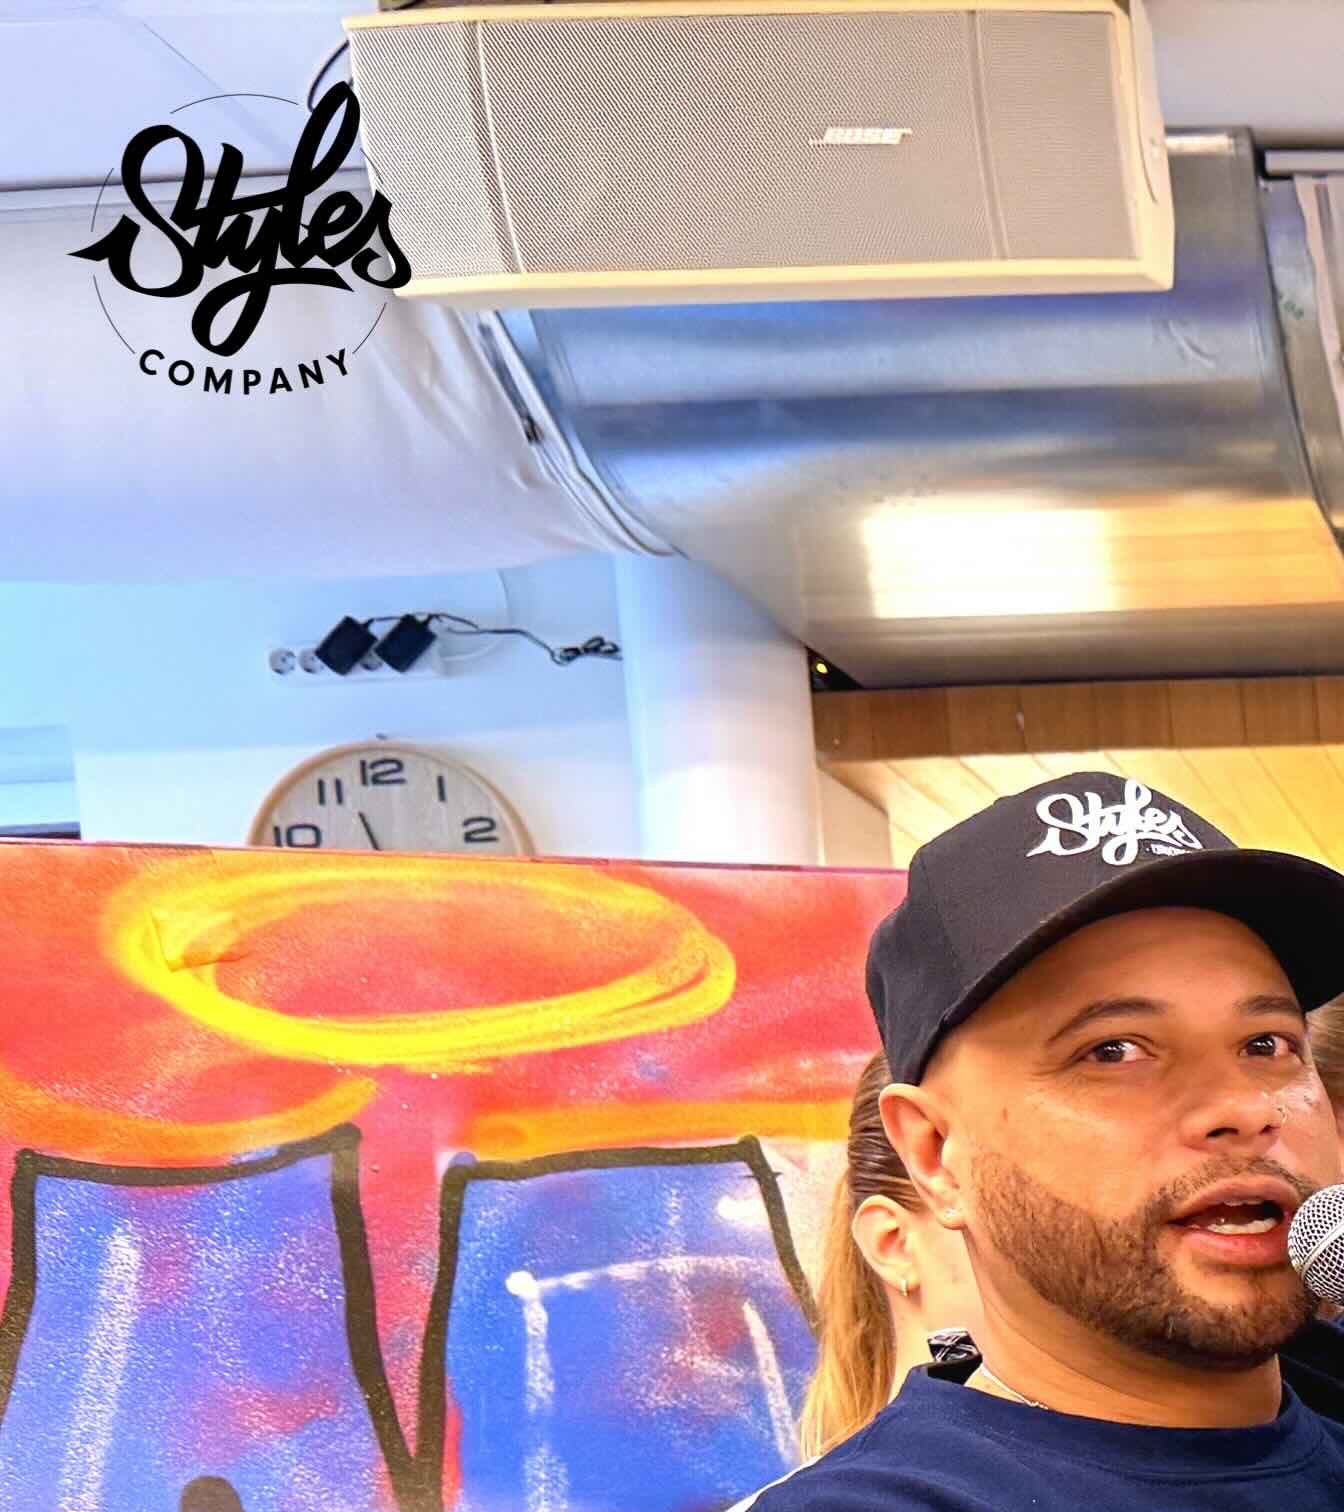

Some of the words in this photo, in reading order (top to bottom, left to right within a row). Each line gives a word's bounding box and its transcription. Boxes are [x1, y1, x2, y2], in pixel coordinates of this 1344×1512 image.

[360, 758, 407, 786] 12
[317, 777, 343, 805] 11
[273, 823, 322, 848] 10
[461, 816, 499, 843] 2
[1025, 778, 1204, 866] Styles
